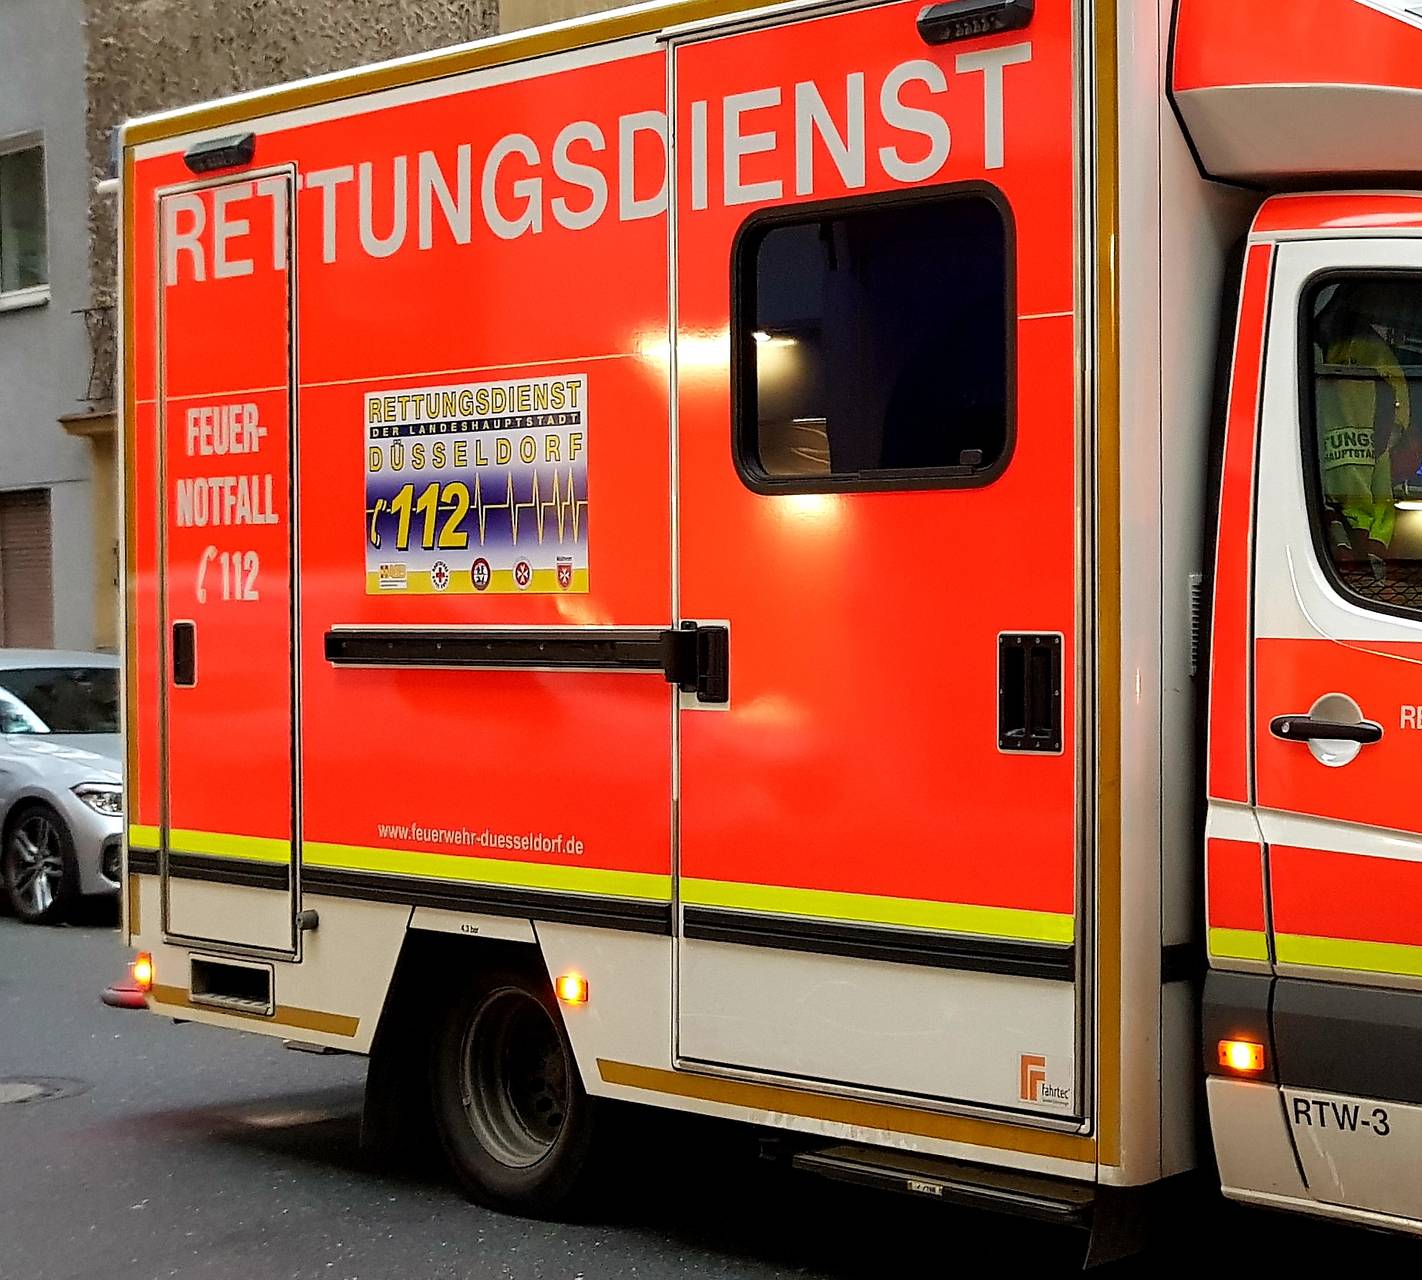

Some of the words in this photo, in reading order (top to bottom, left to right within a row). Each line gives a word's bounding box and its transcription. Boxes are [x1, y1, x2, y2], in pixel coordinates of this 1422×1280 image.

[165, 42, 1032, 286] RETTUNGSDIENST
[368, 380, 582, 424] RETTUNGSDIENST
[372, 426, 400, 437] DER
[409, 412, 579, 436] LANDESHAUPTSTADT
[187, 403, 267, 456] FEUER-
[368, 432, 583, 472] DÜSSELDORF
[176, 473, 279, 527] NOTFALL
[390, 481, 470, 551] 112
[220, 550, 259, 601] 112
[377, 822, 584, 855] www.feuerwehr-duesseldorf.de
[1293, 1097, 1390, 1136] RTW-3
